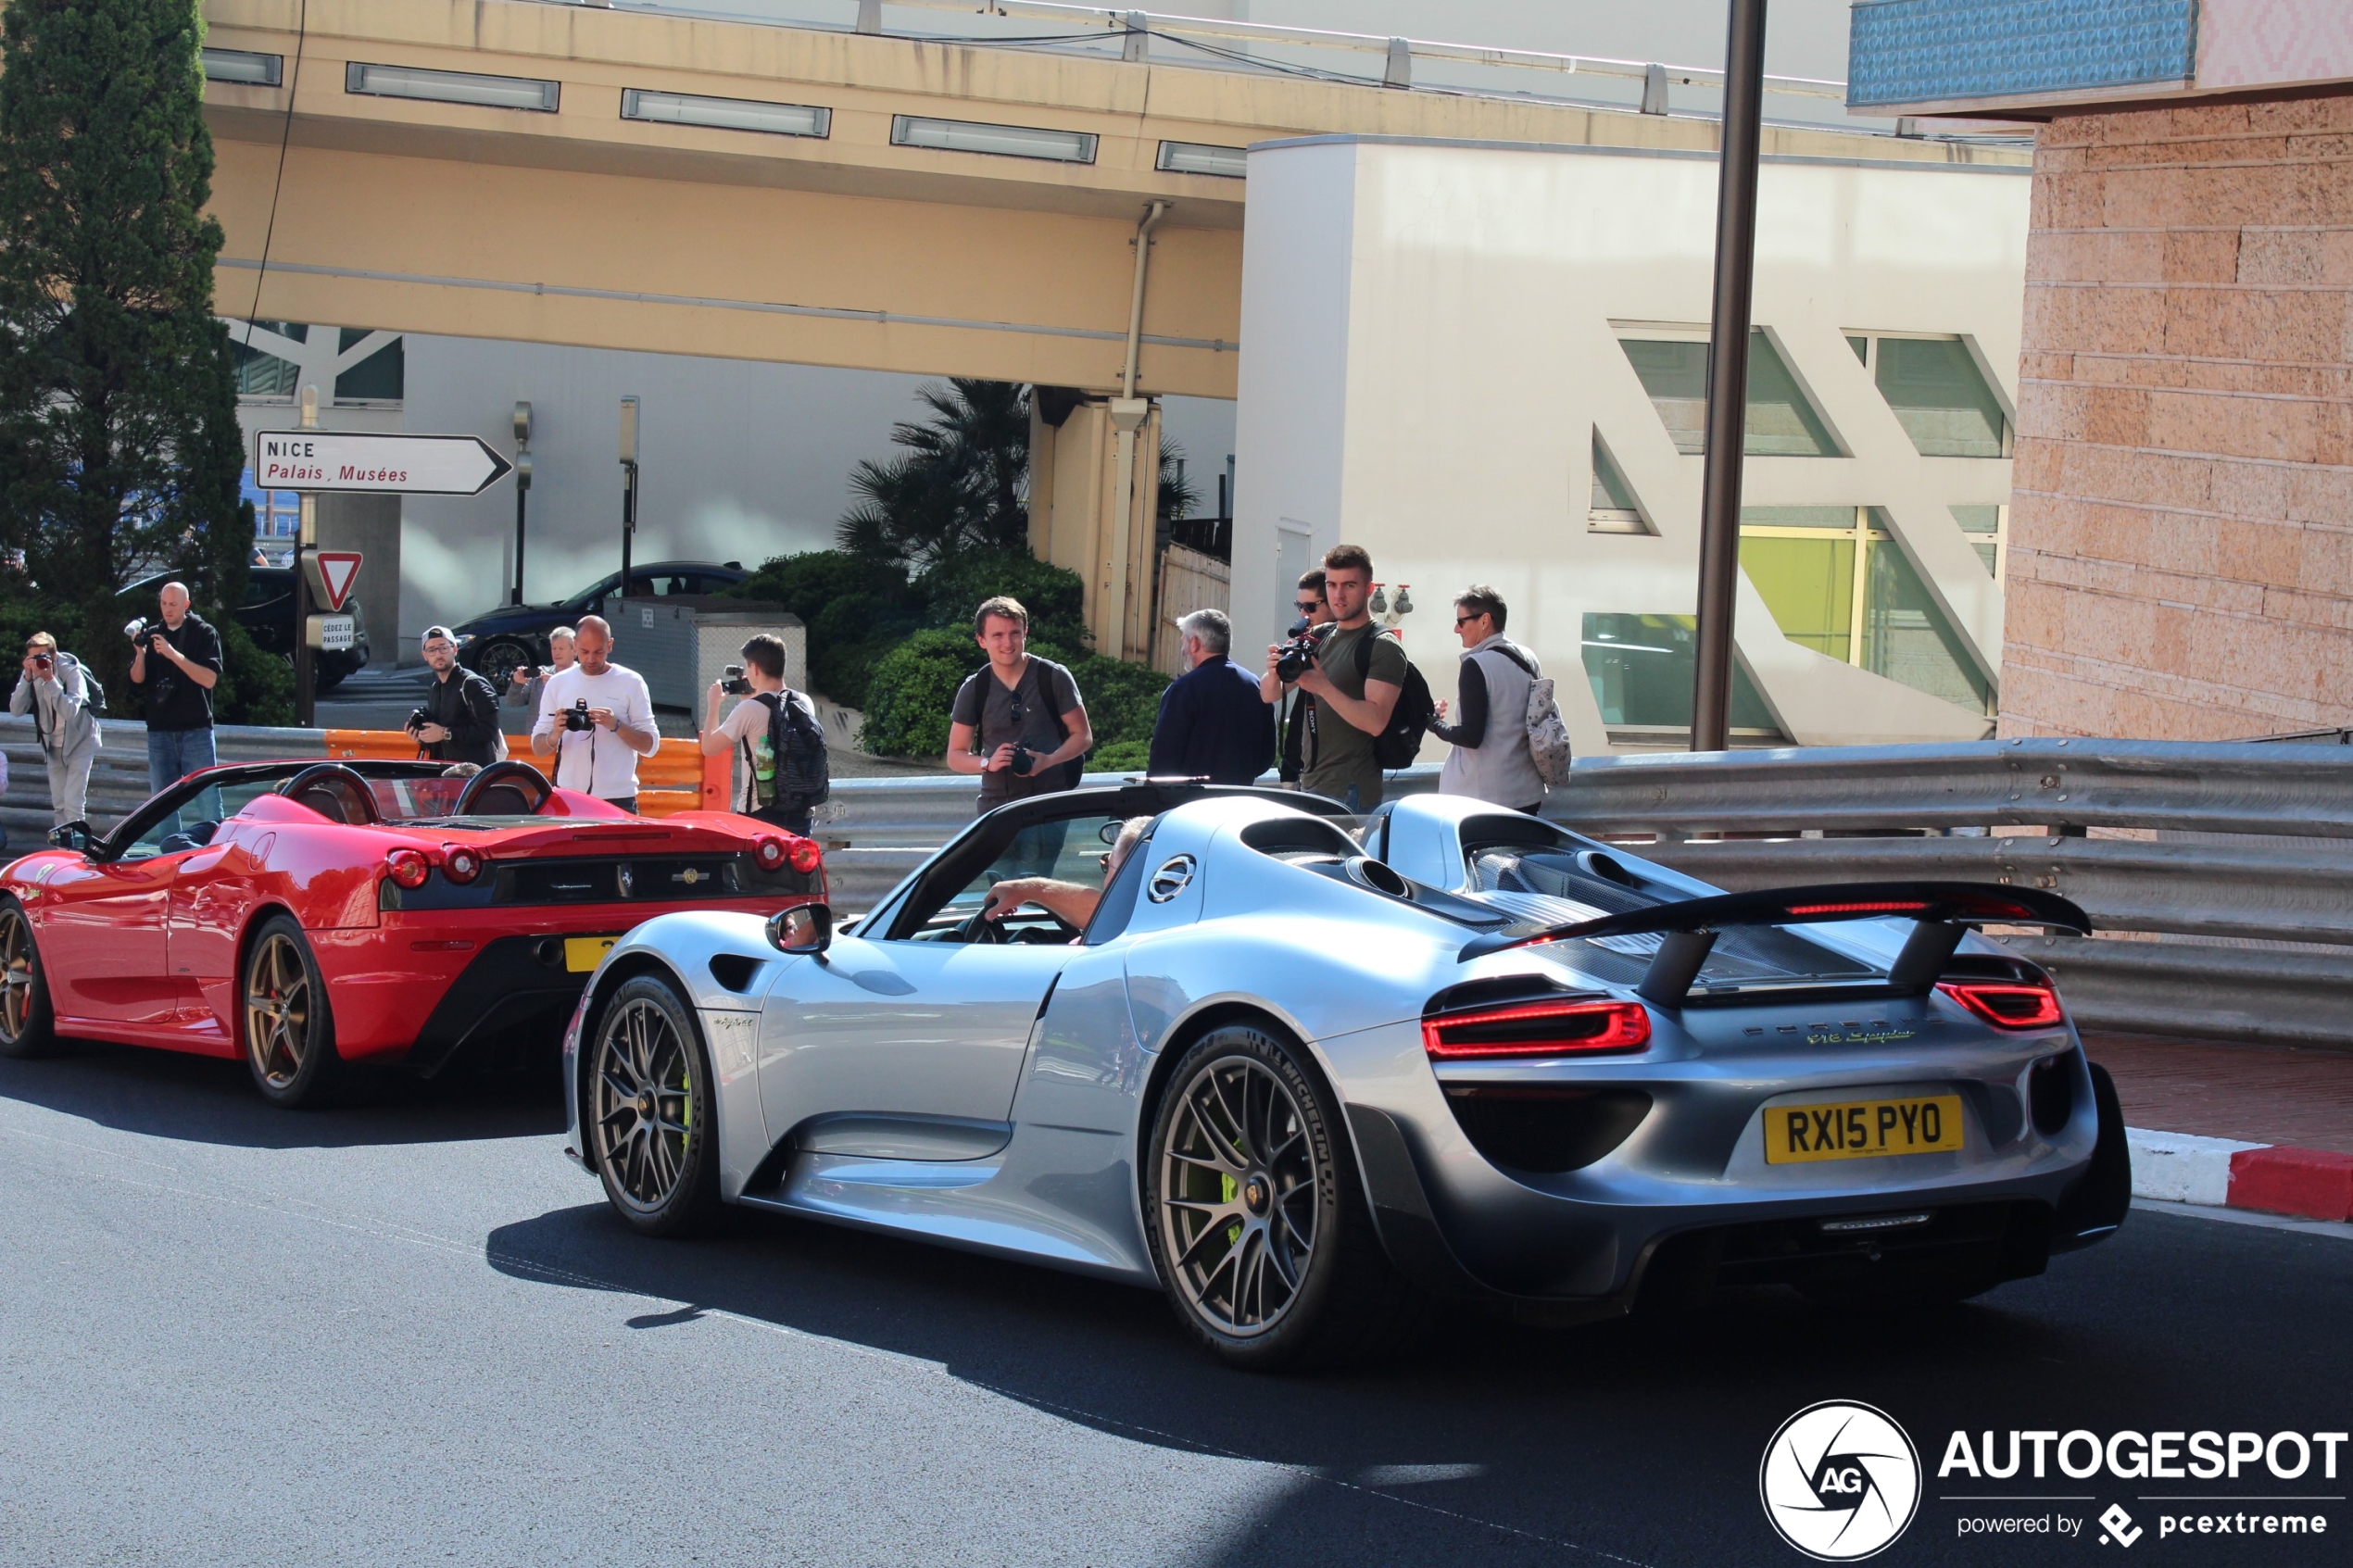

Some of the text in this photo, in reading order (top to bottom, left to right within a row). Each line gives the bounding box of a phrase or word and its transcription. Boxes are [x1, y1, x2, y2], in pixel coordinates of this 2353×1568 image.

[267, 442, 314, 458] NICE
[339, 466, 408, 482] Musées
[323, 623, 342, 632] CÉDEZ
[323, 634, 352, 643] PASSAGE
[1308, 709, 1316, 734] SONY
[1807, 1033, 1843, 1045] 918
[1282, 1060, 1330, 1161] MICHELIN
[1787, 1108, 1868, 1152] RX15
